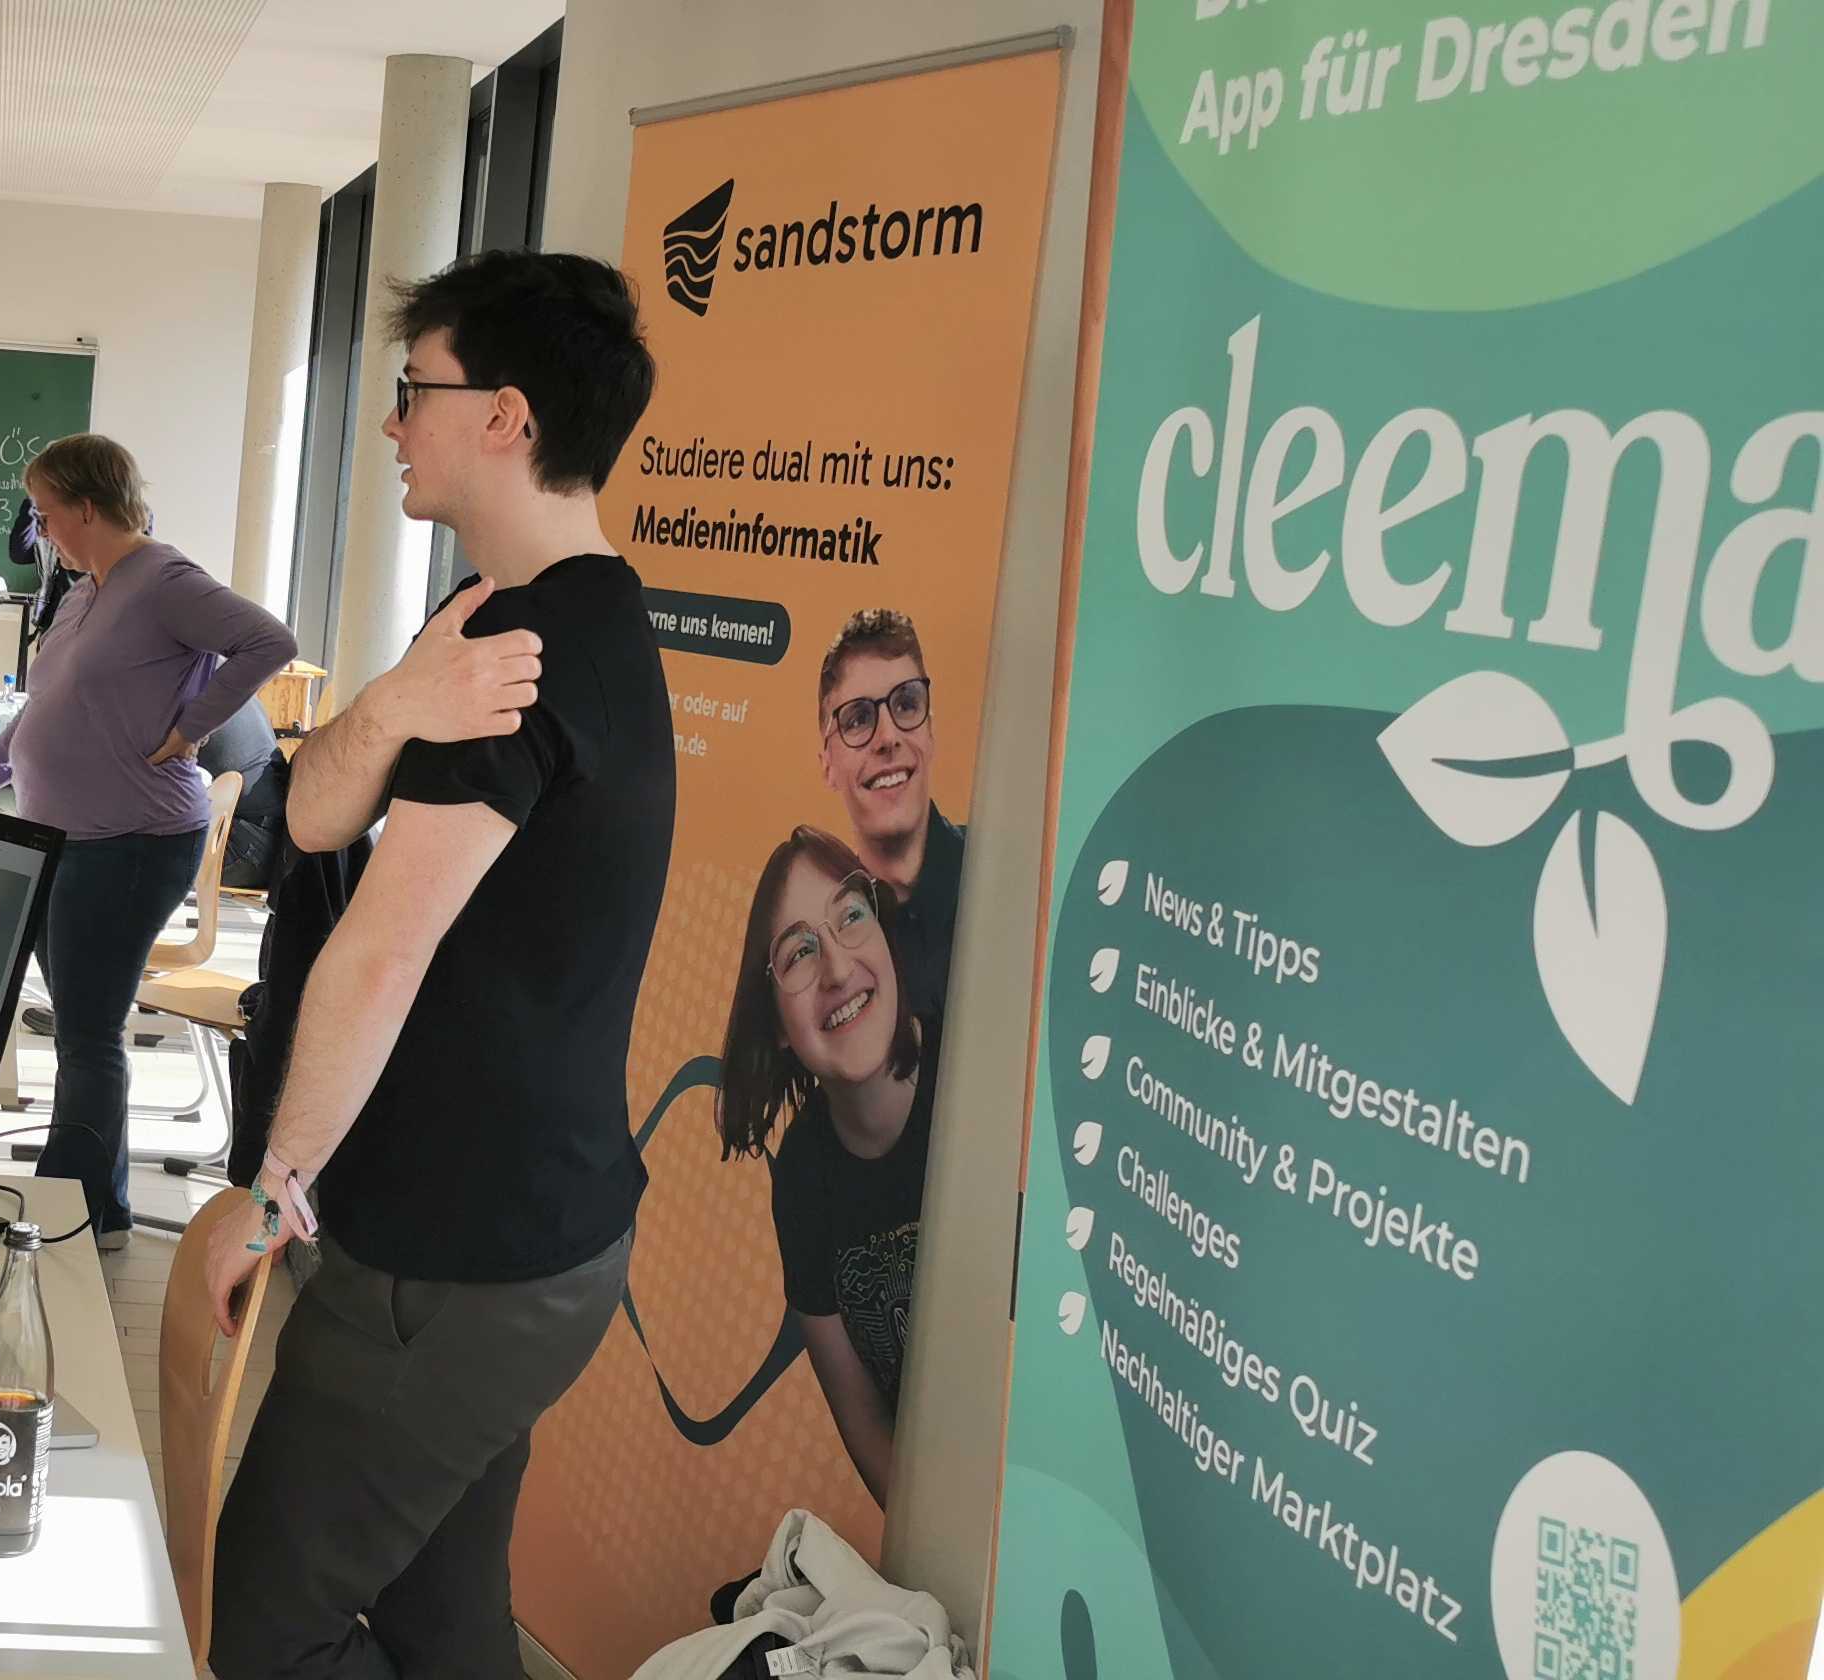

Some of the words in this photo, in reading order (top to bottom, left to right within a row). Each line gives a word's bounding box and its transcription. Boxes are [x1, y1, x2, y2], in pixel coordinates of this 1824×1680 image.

[1179, 68, 1283, 156] App
[1299, 29, 1402, 120] für
[1416, 0, 1772, 103] Dresden
[734, 201, 983, 272] sandstorm
[640, 435, 744, 479] Studiere
[752, 439, 812, 482] dual
[820, 440, 872, 486] mit
[883, 454, 954, 490] uns:
[632, 504, 883, 566] Medieninformatik
[1137, 313, 1824, 745] cleema
[648, 610, 677, 632] rne
[680, 614, 708, 638] uns
[711, 613, 776, 646] kennen!
[684, 692, 719, 718] oder
[721, 699, 749, 724] auf
[1144, 872, 1203, 937] News
[1207, 902, 1224, 948] &
[1233, 909, 1321, 984] Tipps
[1135, 963, 1236, 1056] Einblicke
[1242, 1021, 1264, 1070] &
[1273, 1033, 1531, 1184] Mitgestalten
[1117, 1145, 1241, 1269] Challenges
[1125, 1055, 1268, 1184] Community
[1273, 1144, 1297, 1194] &
[1307, 1158, 1479, 1281] Projekte
[1108, 1231, 1280, 1404] Regelmäßiges
[1289, 1375, 1378, 1466] Quiz
[1100, 1320, 1244, 1485] Nachhaltiger
[1251, 1456, 1463, 1643] Marktplatz
